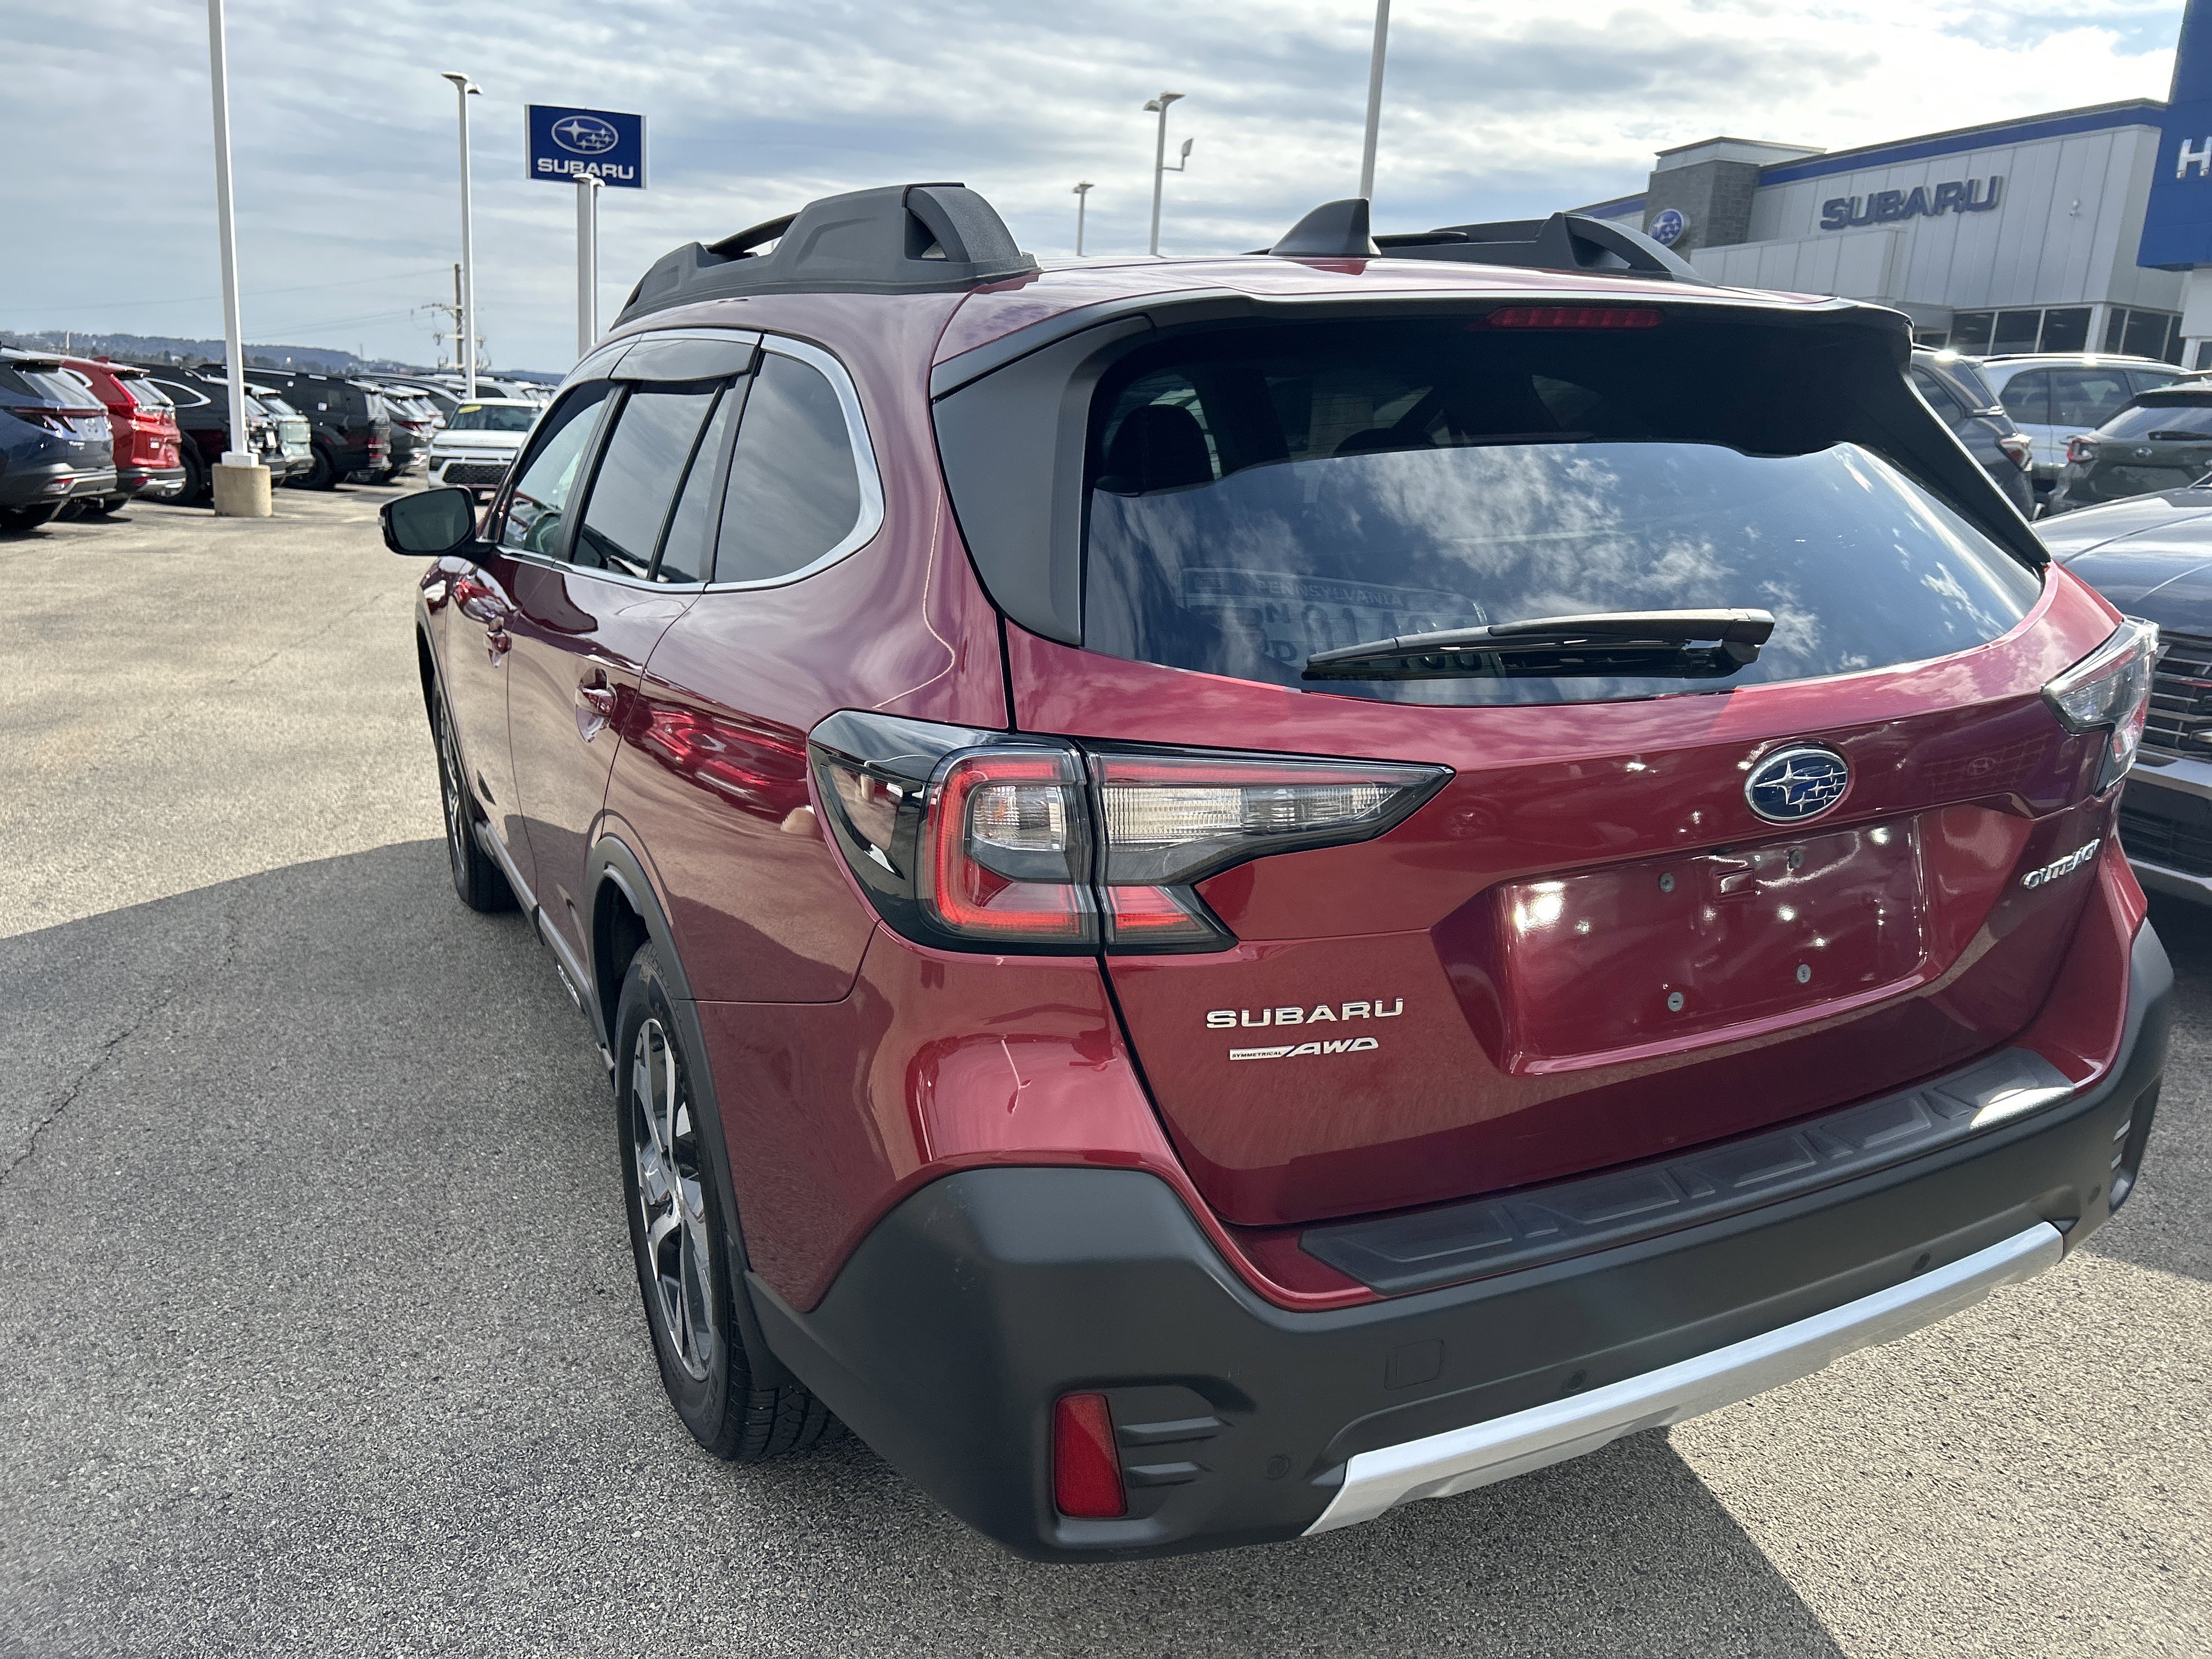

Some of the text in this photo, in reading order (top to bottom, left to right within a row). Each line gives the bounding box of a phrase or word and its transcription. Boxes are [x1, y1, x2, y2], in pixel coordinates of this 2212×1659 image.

[537, 157, 634, 179] SUBARU
[1820, 174, 2003, 229] SUBARU
[1206, 997, 1404, 1029] SUBARU
[1231, 1037, 1379, 1059] SYMMETRICAL AWD
